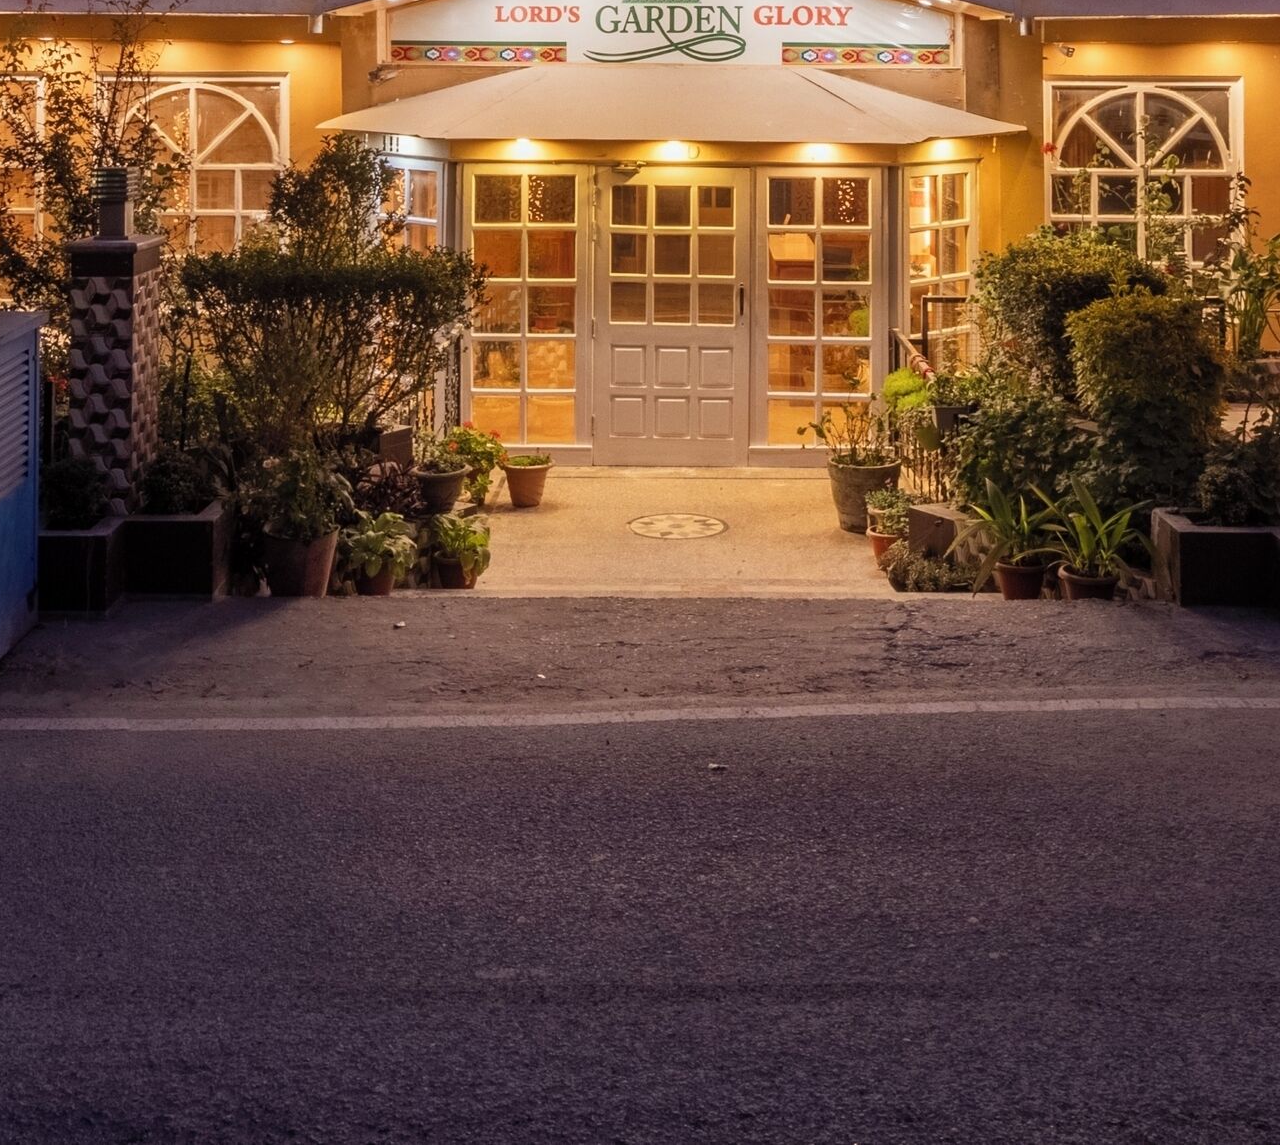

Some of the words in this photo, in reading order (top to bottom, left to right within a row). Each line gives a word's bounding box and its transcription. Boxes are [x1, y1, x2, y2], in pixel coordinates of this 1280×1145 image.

[494, 5, 581, 24] LORD'S
[594, 4, 743, 35] GARDEN
[753, 6, 854, 27] GLORY
